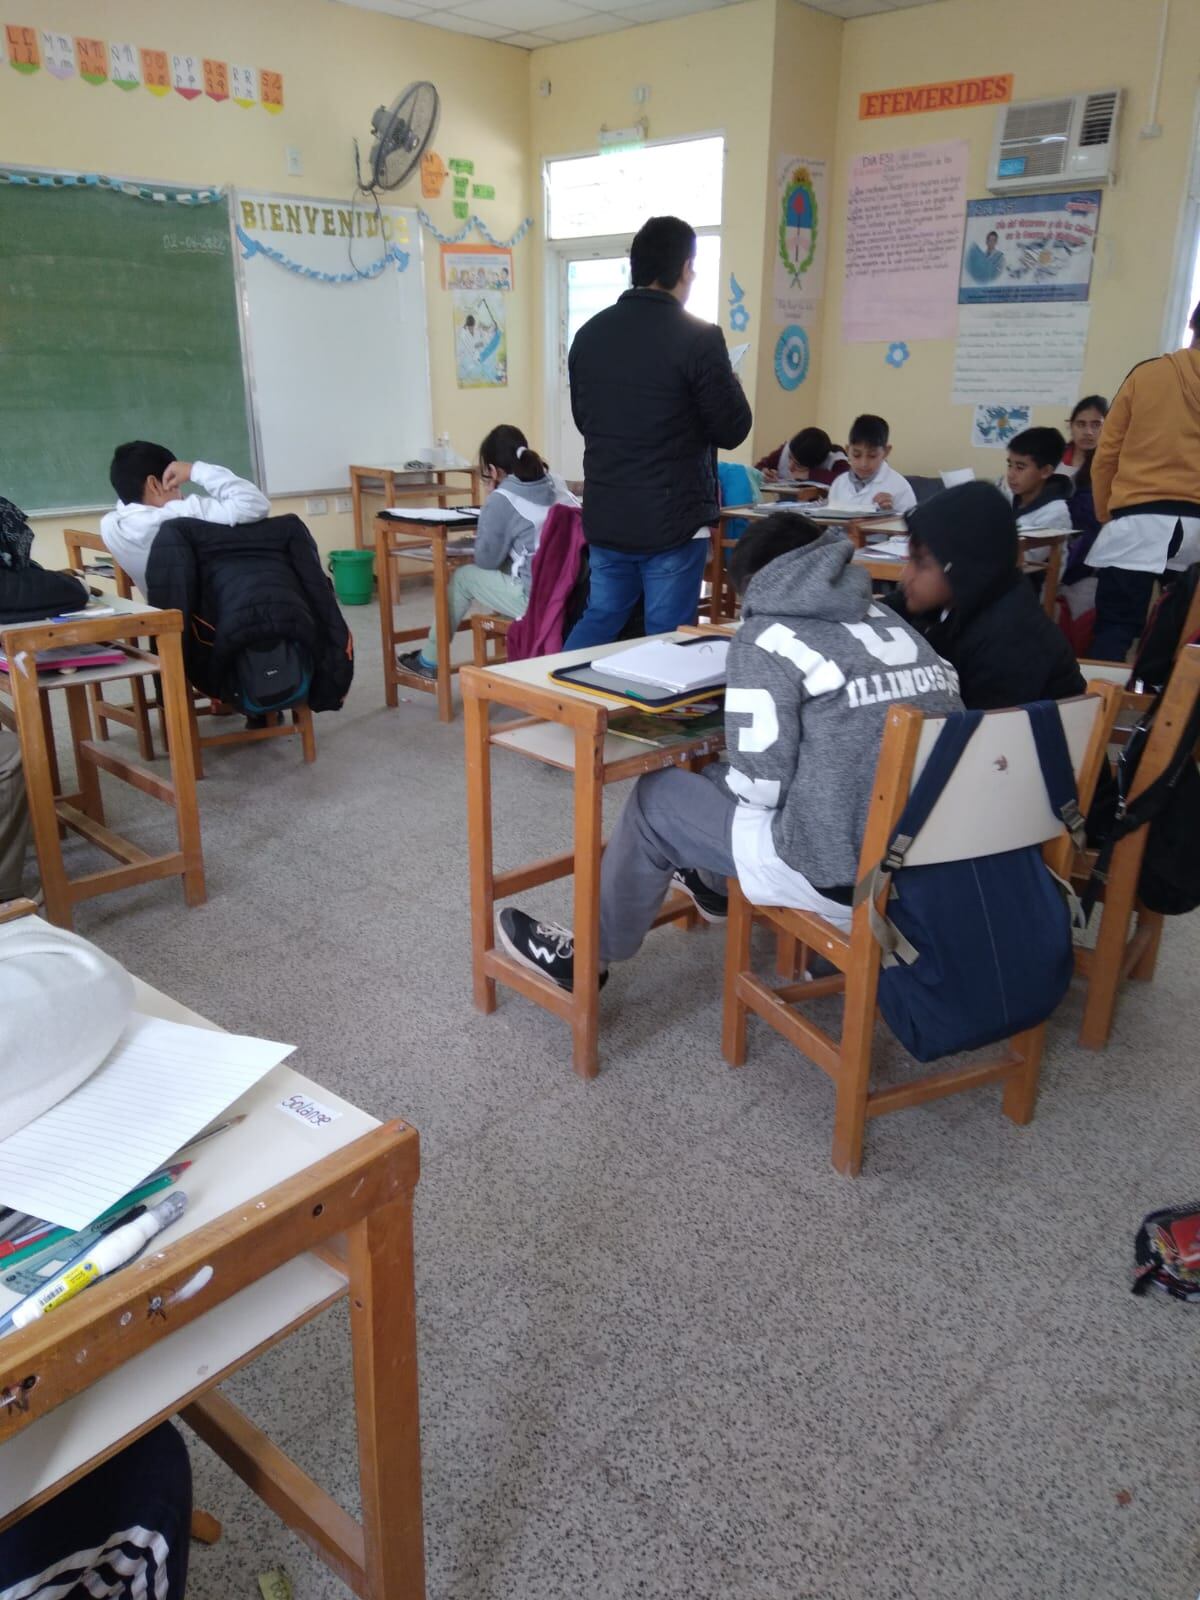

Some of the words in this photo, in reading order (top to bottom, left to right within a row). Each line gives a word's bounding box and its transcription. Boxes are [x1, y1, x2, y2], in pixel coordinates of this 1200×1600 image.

[864, 77, 1008, 116] EFEMERIDES
[240, 201, 409, 244] BIENVENIDOS
[281, 1095, 332, 1127] Solange
